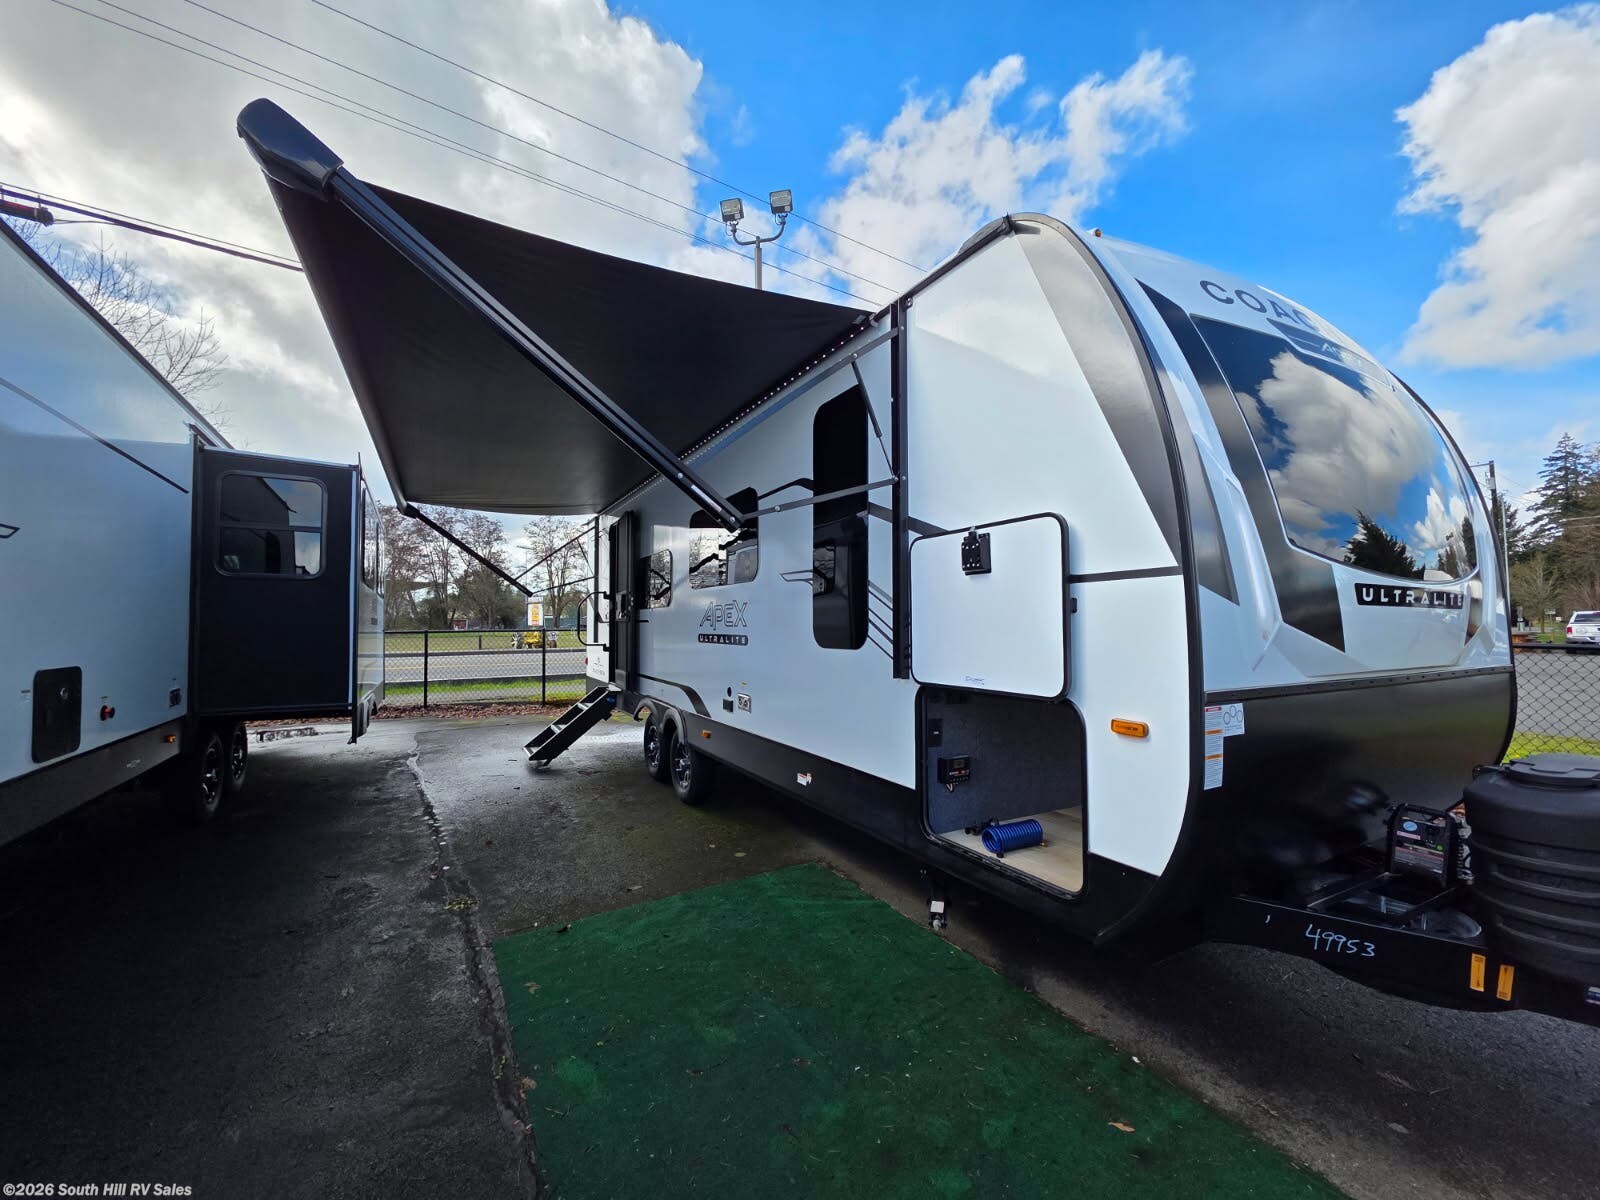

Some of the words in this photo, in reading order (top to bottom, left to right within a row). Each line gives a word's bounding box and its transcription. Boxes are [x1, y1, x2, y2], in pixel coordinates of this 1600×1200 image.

[1362, 587, 1462, 606] ULTRALITE
[699, 600, 748, 631] APEX
[699, 635, 746, 645] ULTRALITE
[1305, 923, 1375, 957] 49953
